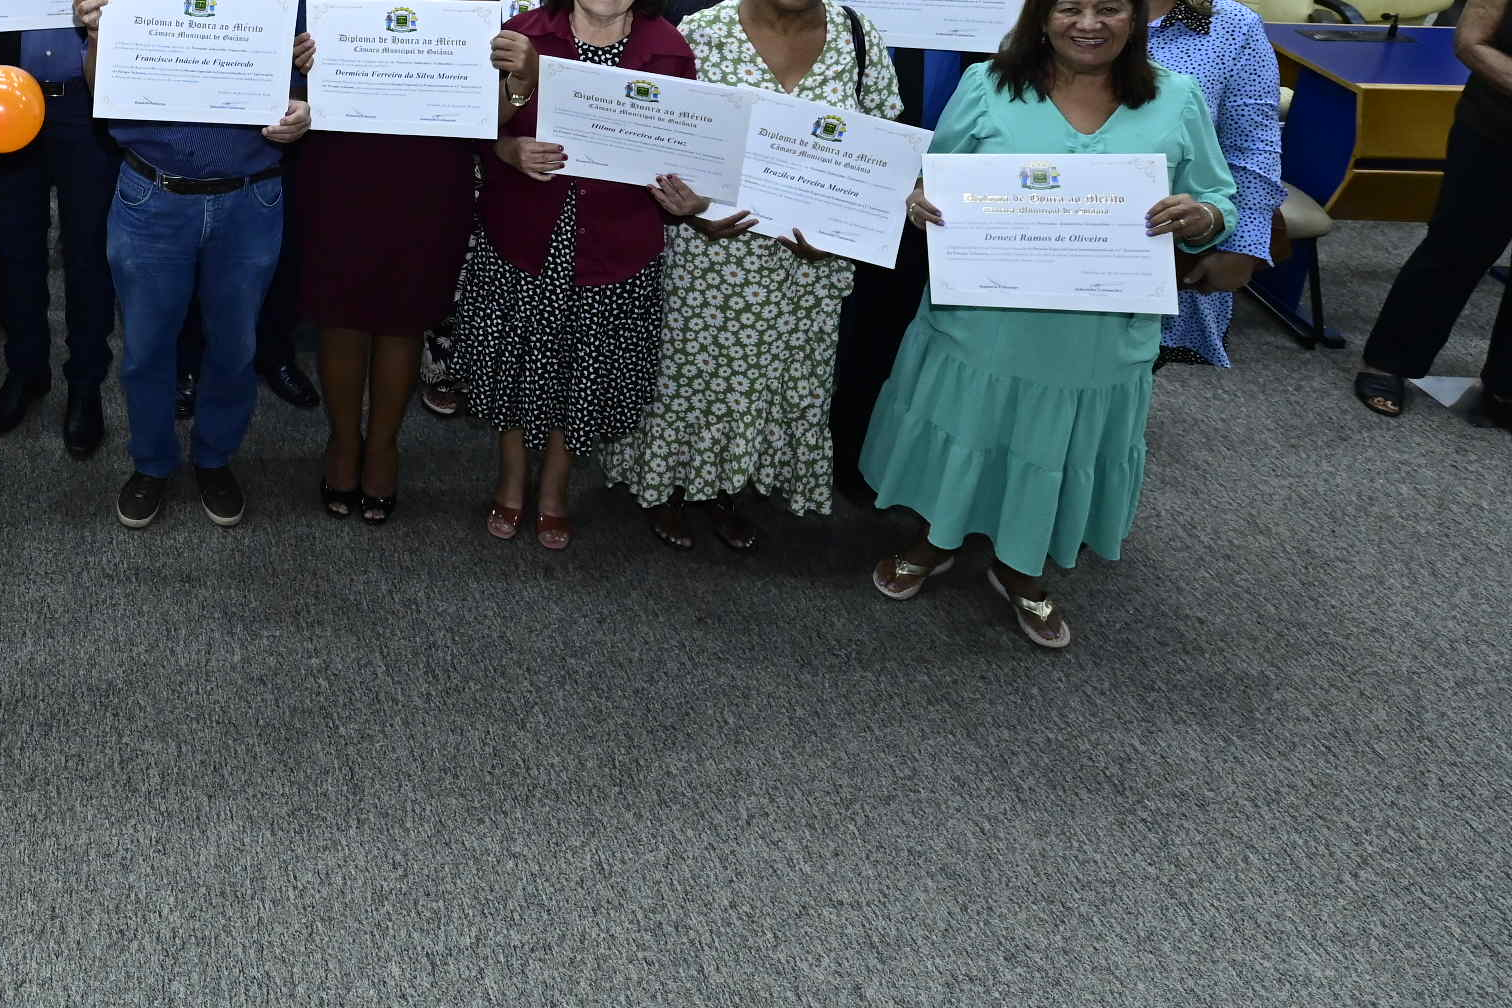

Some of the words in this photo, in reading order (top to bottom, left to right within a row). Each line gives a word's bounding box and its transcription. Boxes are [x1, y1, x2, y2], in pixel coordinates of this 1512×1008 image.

[134, 16, 172, 27] Diploma
[176, 20, 185, 28] de
[188, 19, 216, 30] Honra
[232, 23, 264, 33] Mérito
[339, 34, 375, 43] Diploma
[378, 36, 388, 44] de
[392, 36, 419, 45] Honra
[435, 38, 466, 46] Mérito
[135, 54, 173, 64] Francisco
[213, 58, 254, 68] Figueiredo
[574, 92, 613, 105] Diploma
[630, 101, 661, 113] Honra
[678, 109, 712, 122] Mérito
[619, 127, 652, 140] Ferreira
[655, 134, 664, 142] da
[667, 136, 687, 146] Cruz
[759, 128, 796, 144] Diploma
[812, 141, 840, 155] Honra
[843, 150, 852, 158] ao
[856, 153, 887, 167] Mérito
[798, 176, 825, 189] Pereira
[828, 183, 858, 197] Moreira
